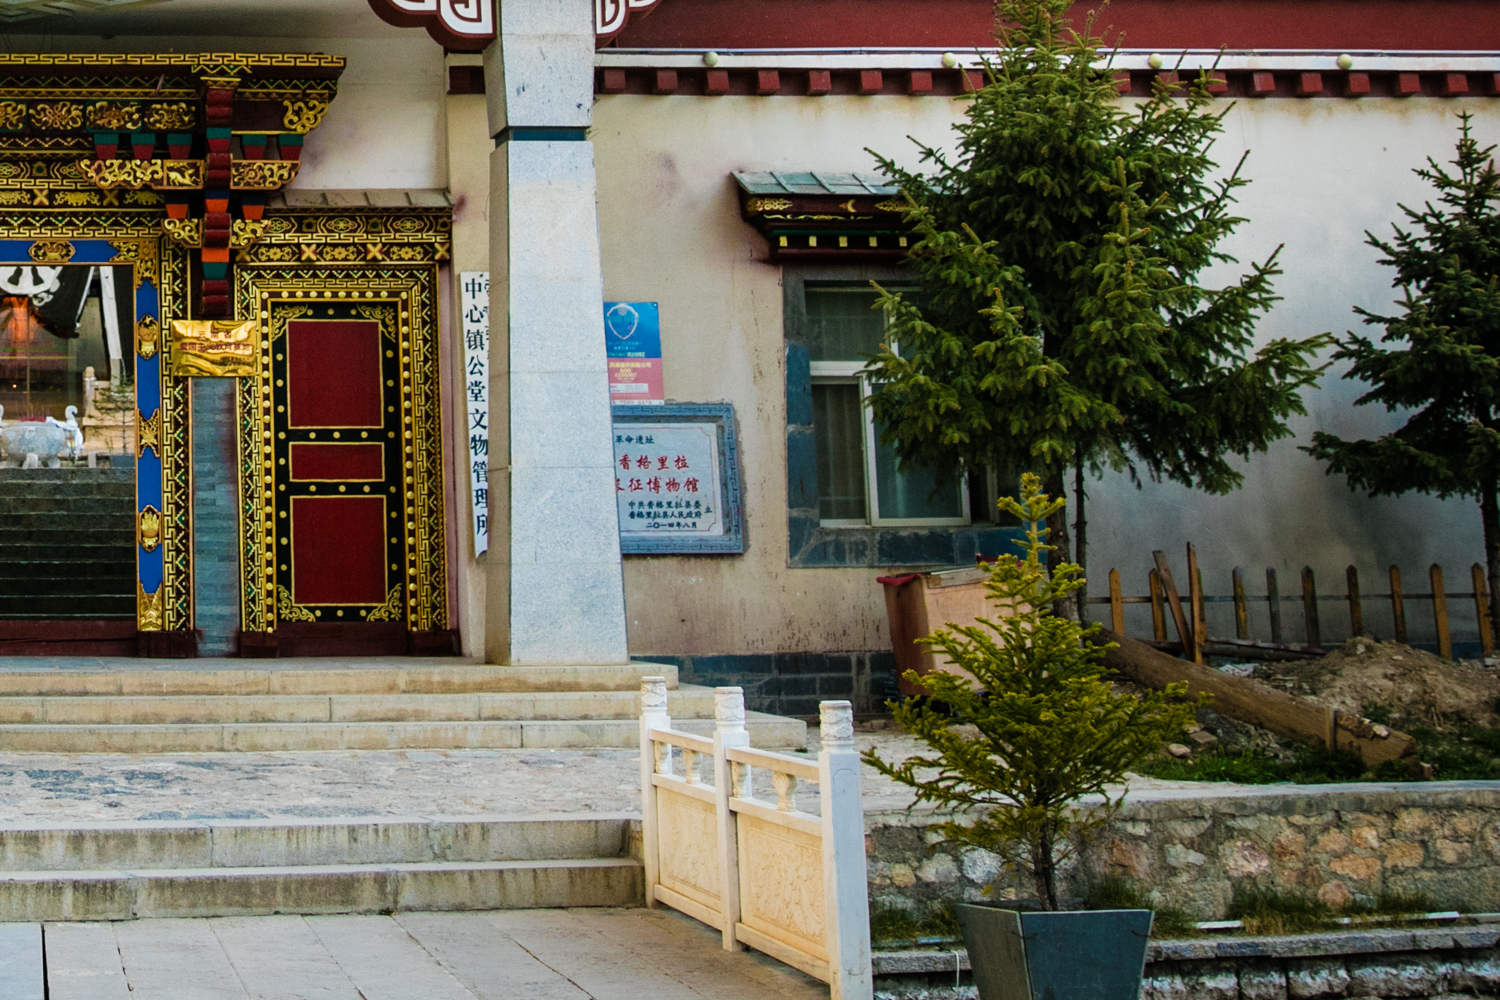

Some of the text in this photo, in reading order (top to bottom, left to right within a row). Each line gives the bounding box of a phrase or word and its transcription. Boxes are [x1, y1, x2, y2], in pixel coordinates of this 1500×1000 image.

[618, 453, 690, 471] 香格里拉
[628, 500, 702, 509] 中共香格里拉县委
[704, 505, 713, 514] 立
[628, 510, 703, 520] 香格里拉县人民政府
